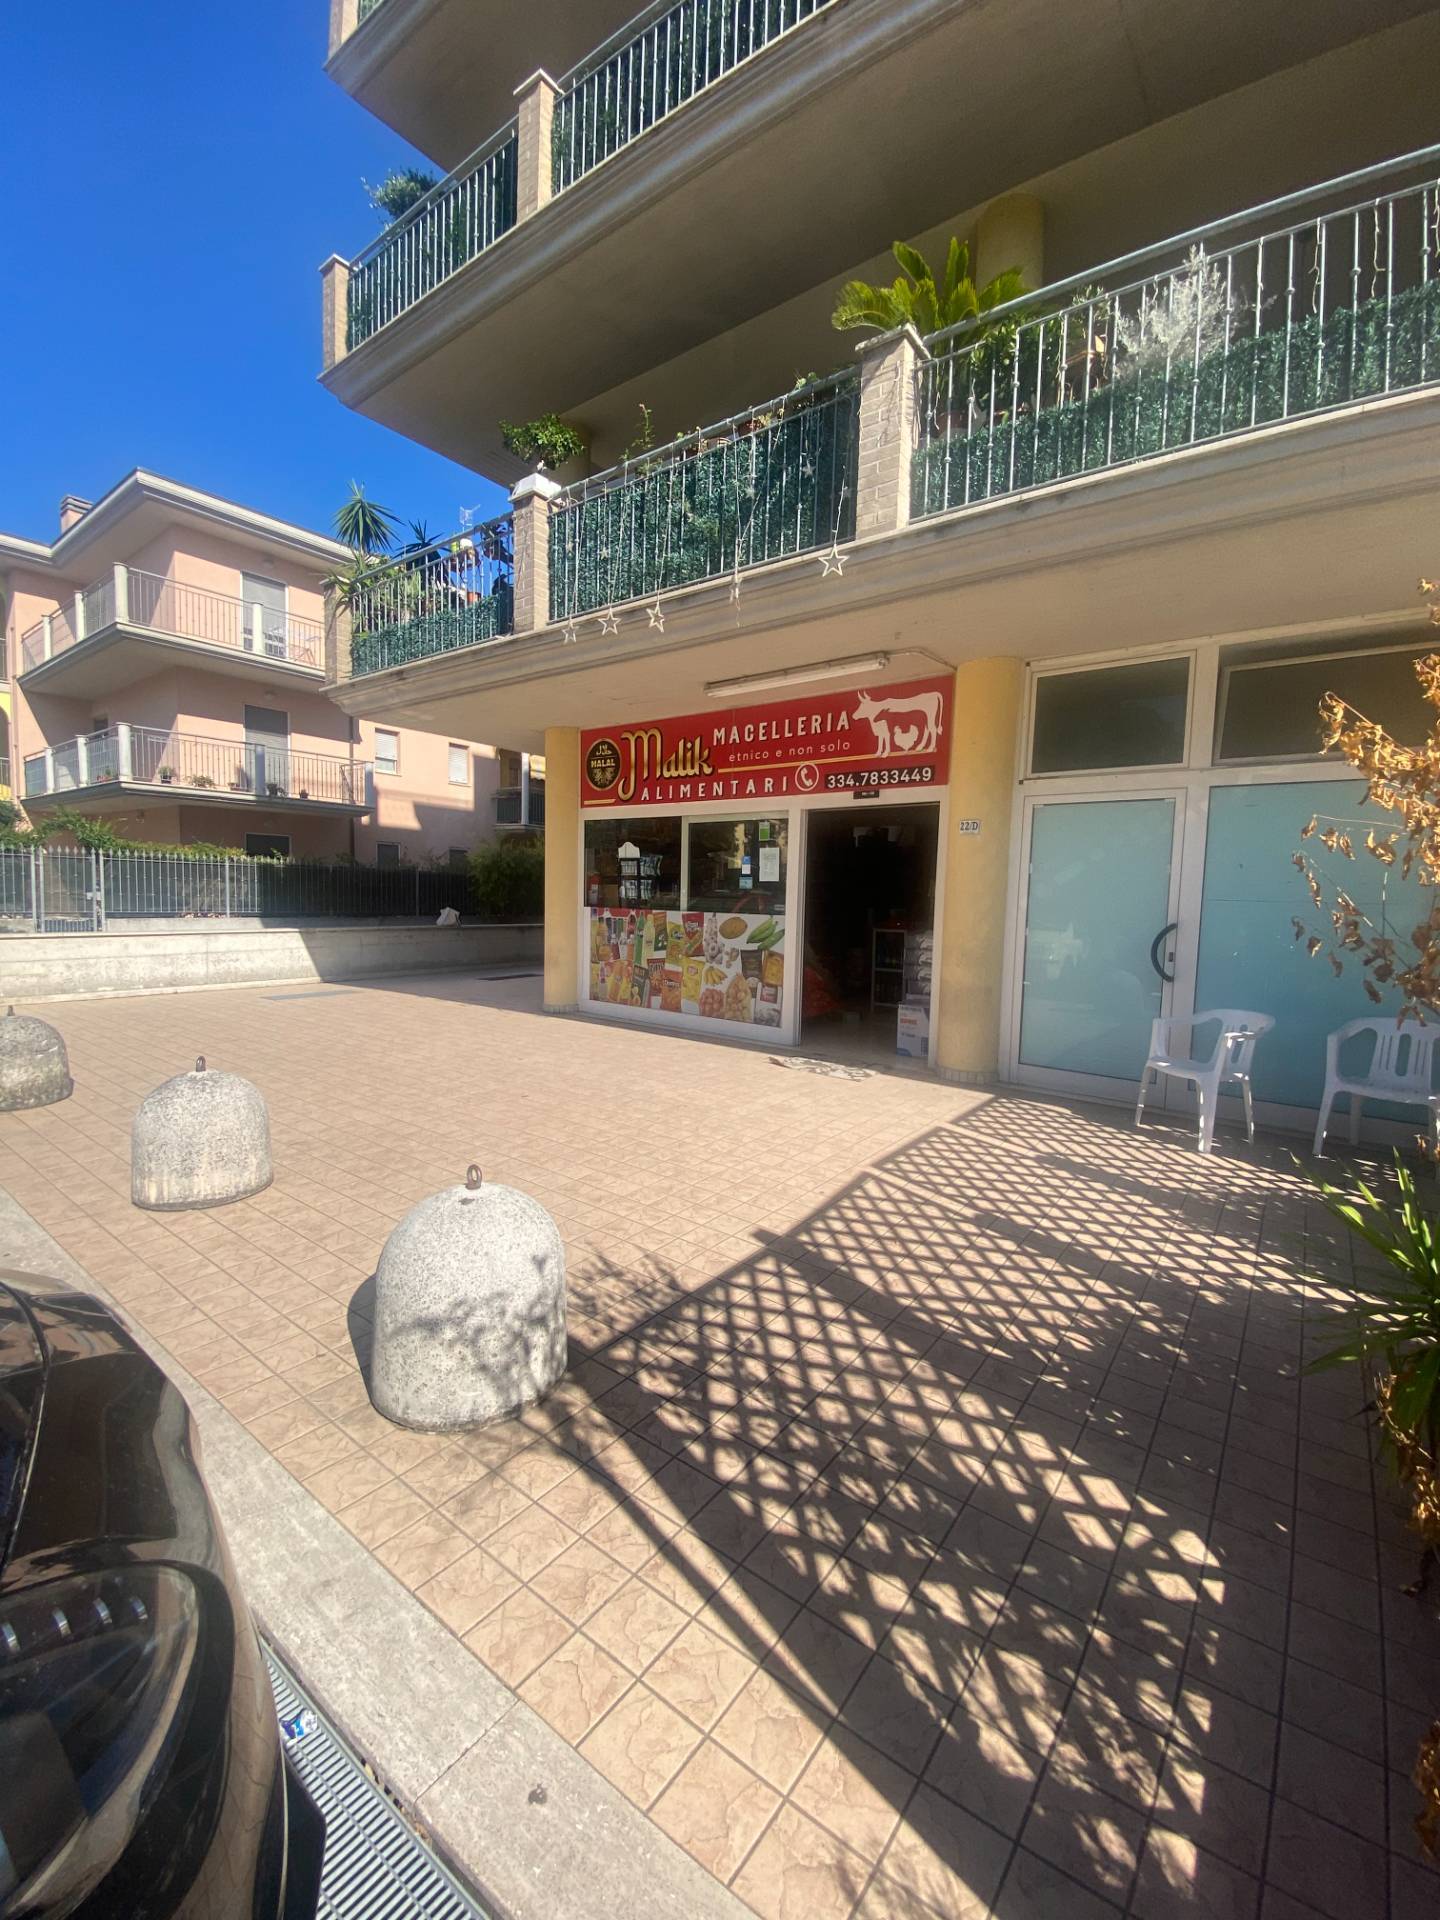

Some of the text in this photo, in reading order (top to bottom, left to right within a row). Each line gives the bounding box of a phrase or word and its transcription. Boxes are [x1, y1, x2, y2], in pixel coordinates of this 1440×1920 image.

[713, 711, 850, 746] MACELLERIA
[728, 739, 851, 762] etnico e non solo
[618, 727, 713, 801] Malik
[641, 776, 788, 801] ALIMENTARI
[827, 767, 932, 789] 334.7833449
